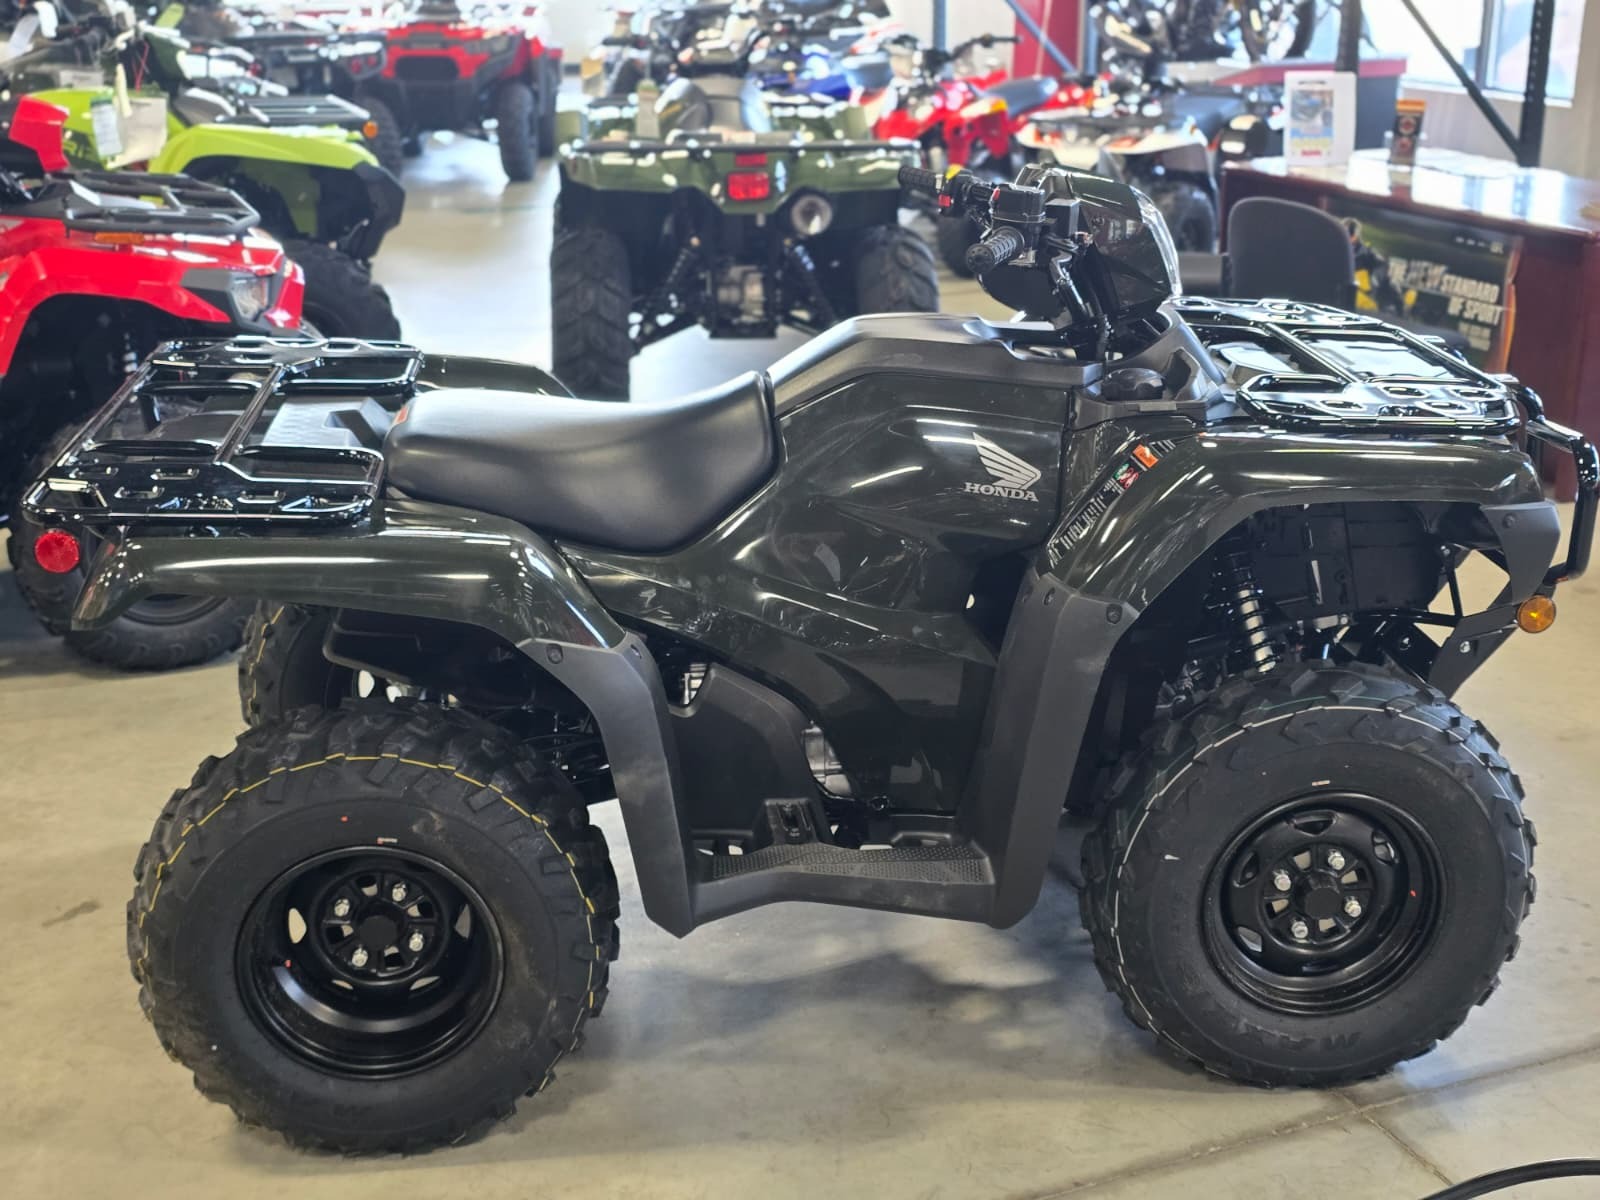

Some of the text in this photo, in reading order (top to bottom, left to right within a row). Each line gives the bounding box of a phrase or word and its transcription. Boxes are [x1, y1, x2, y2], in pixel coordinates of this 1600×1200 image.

[1440, 273, 1500, 304] STANDARD
[1448, 296, 1503, 327] OF SPORT
[963, 482, 1039, 503] HONDA
